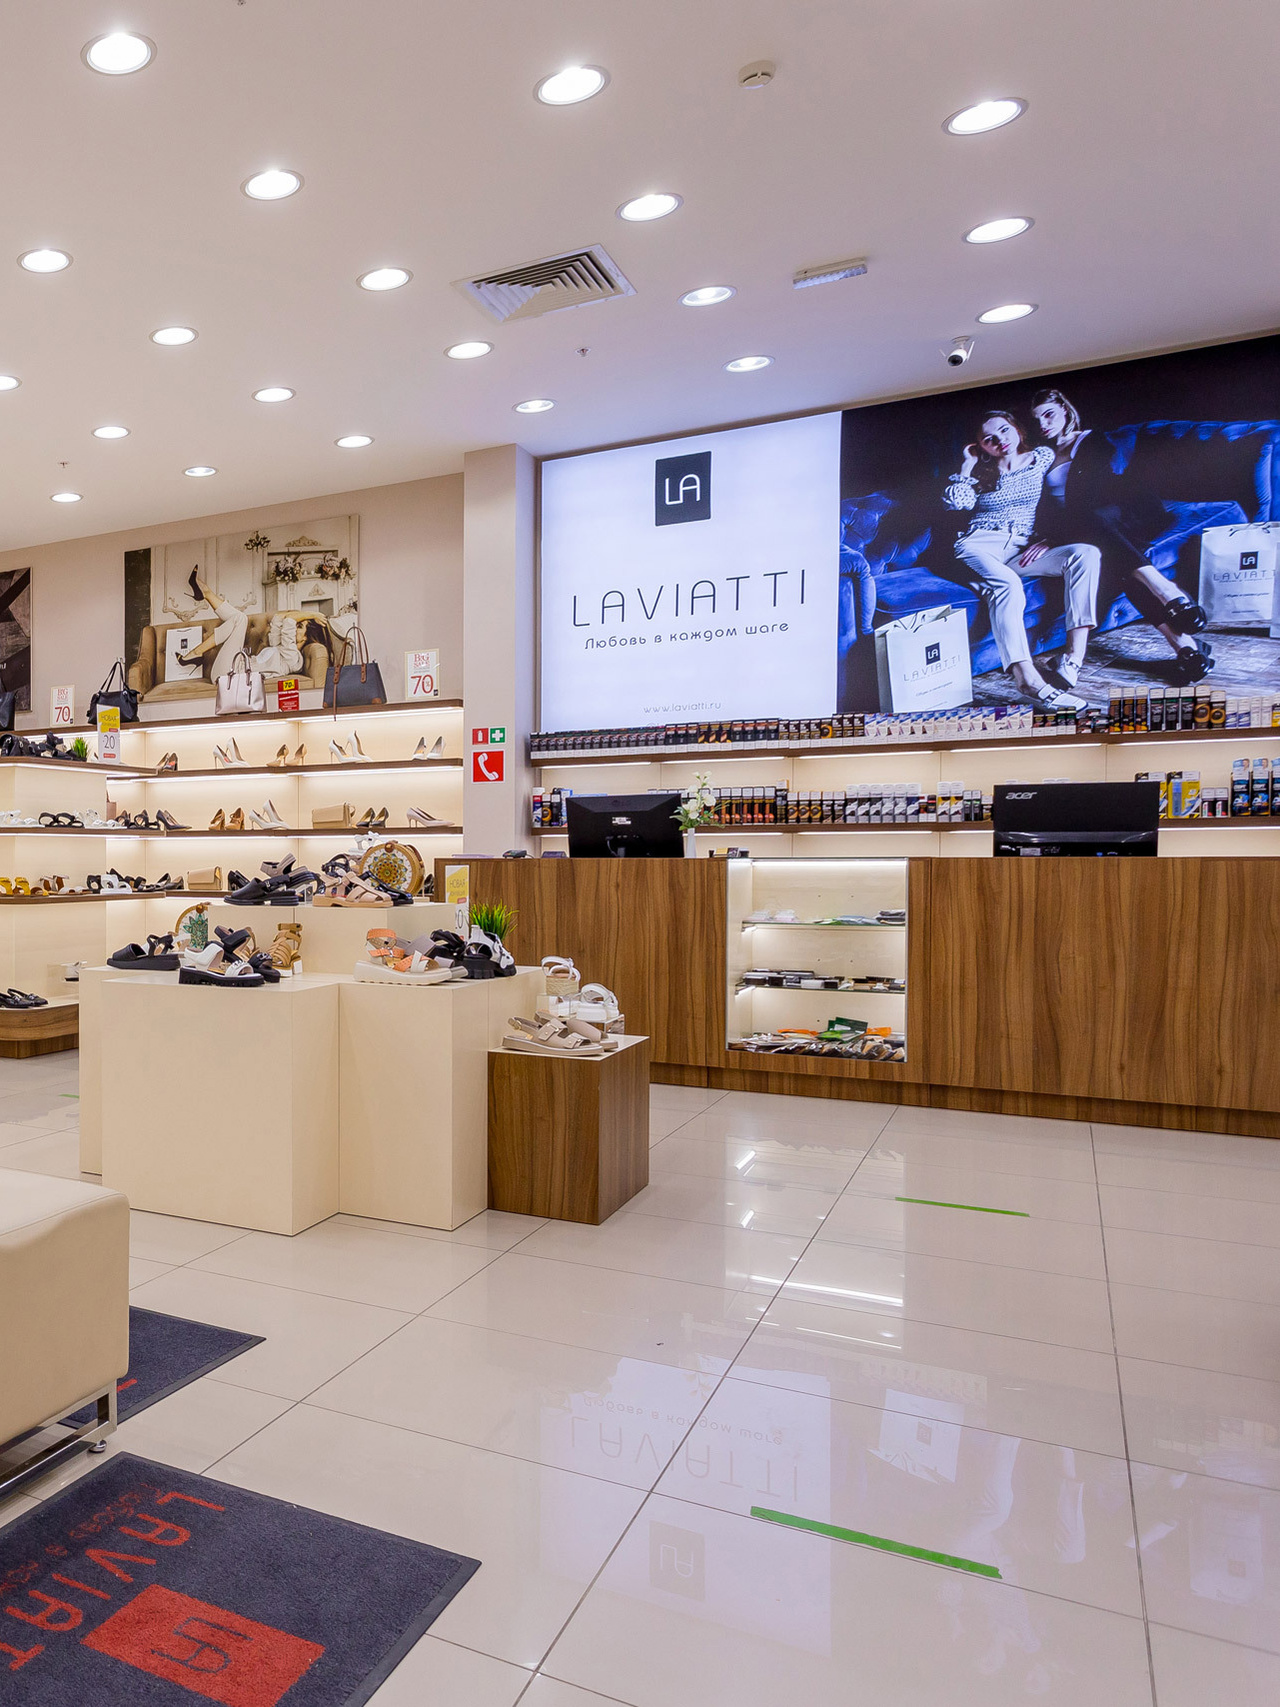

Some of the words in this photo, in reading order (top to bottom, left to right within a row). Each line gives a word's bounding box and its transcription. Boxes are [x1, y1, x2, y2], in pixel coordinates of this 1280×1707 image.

[664, 473, 702, 506] LA
[573, 568, 806, 627] LAVIATTI
[584, 635, 647, 650] Любовь
[654, 633, 662, 644] в
[670, 626, 738, 643] каждом
[745, 621, 789, 636] шаге
[903, 655, 961, 682] LAVIATTI
[643, 700, 722, 714] www.laviatti.ru
[1005, 791, 1038, 800] acer
